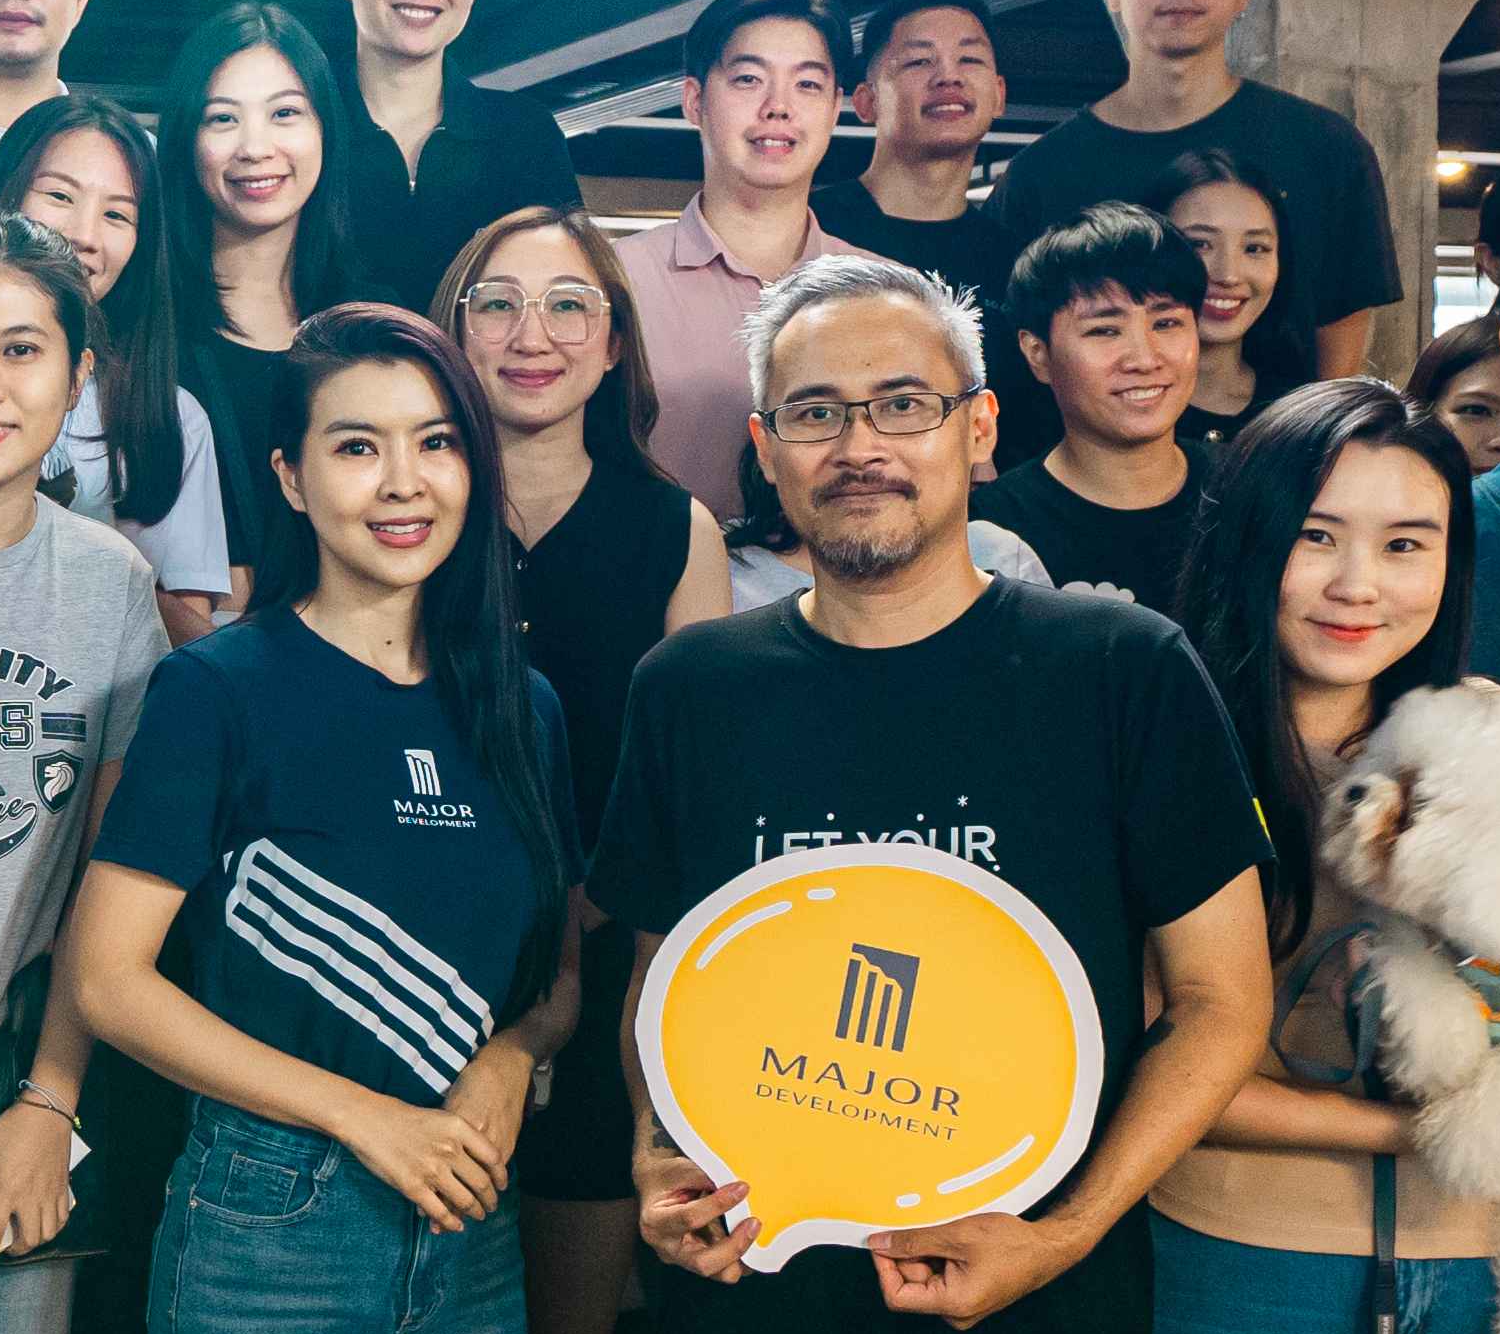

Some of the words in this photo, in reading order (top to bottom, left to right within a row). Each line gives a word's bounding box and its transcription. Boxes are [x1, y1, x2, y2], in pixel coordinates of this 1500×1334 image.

[393, 799, 475, 818] MAJOR
[397, 816, 477, 828] DEVELOPMENT
[761, 1046, 961, 1117] MAJOR
[755, 1083, 959, 1141] DEVELOPMENT
